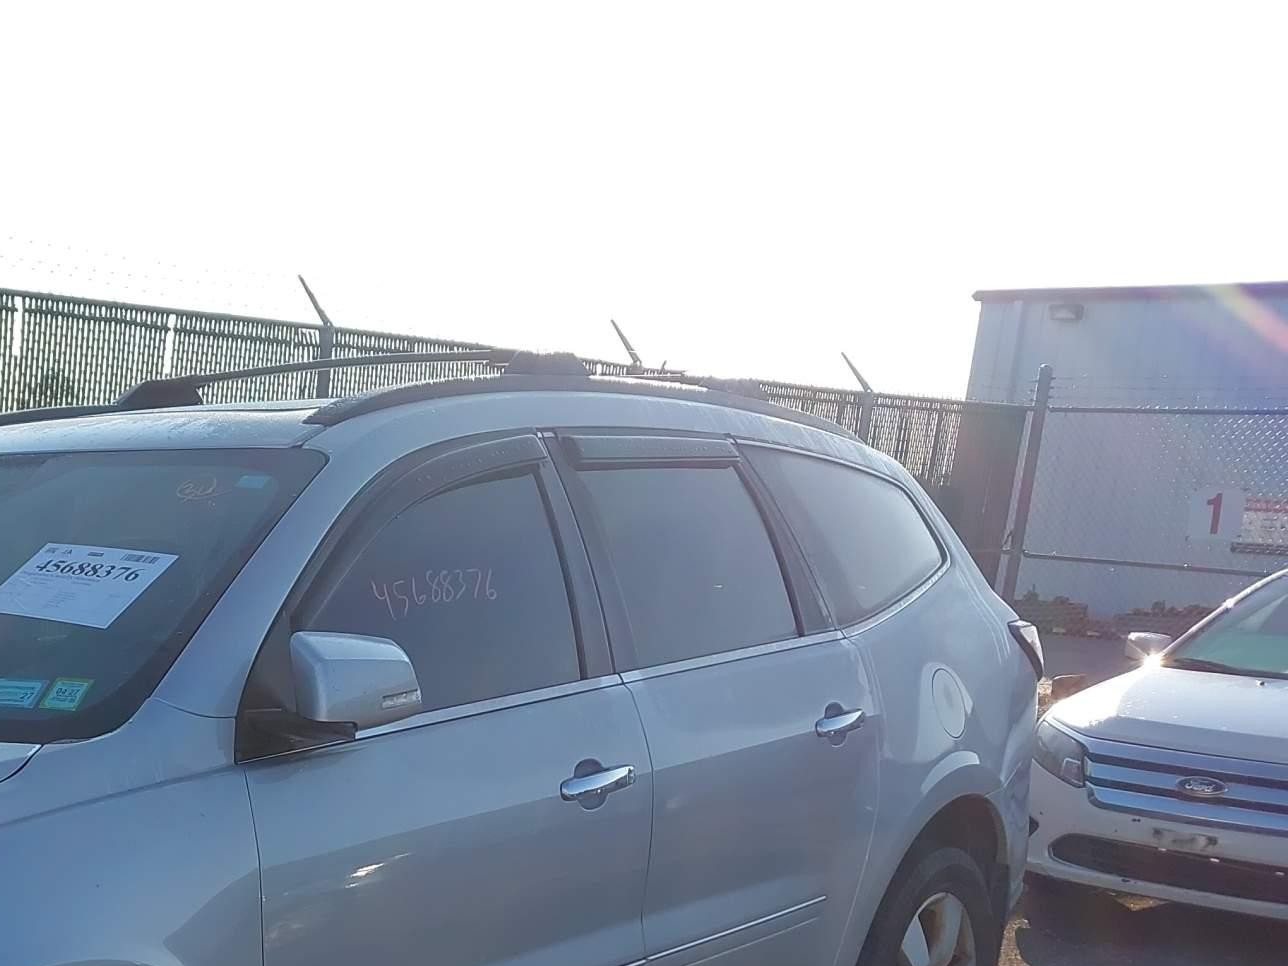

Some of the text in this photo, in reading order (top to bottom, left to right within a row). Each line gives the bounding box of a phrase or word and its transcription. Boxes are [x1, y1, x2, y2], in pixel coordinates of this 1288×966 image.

[1206, 492, 1223, 535] 1
[35, 559, 144, 582] 45688376
[371, 567, 497, 621] 45688376
